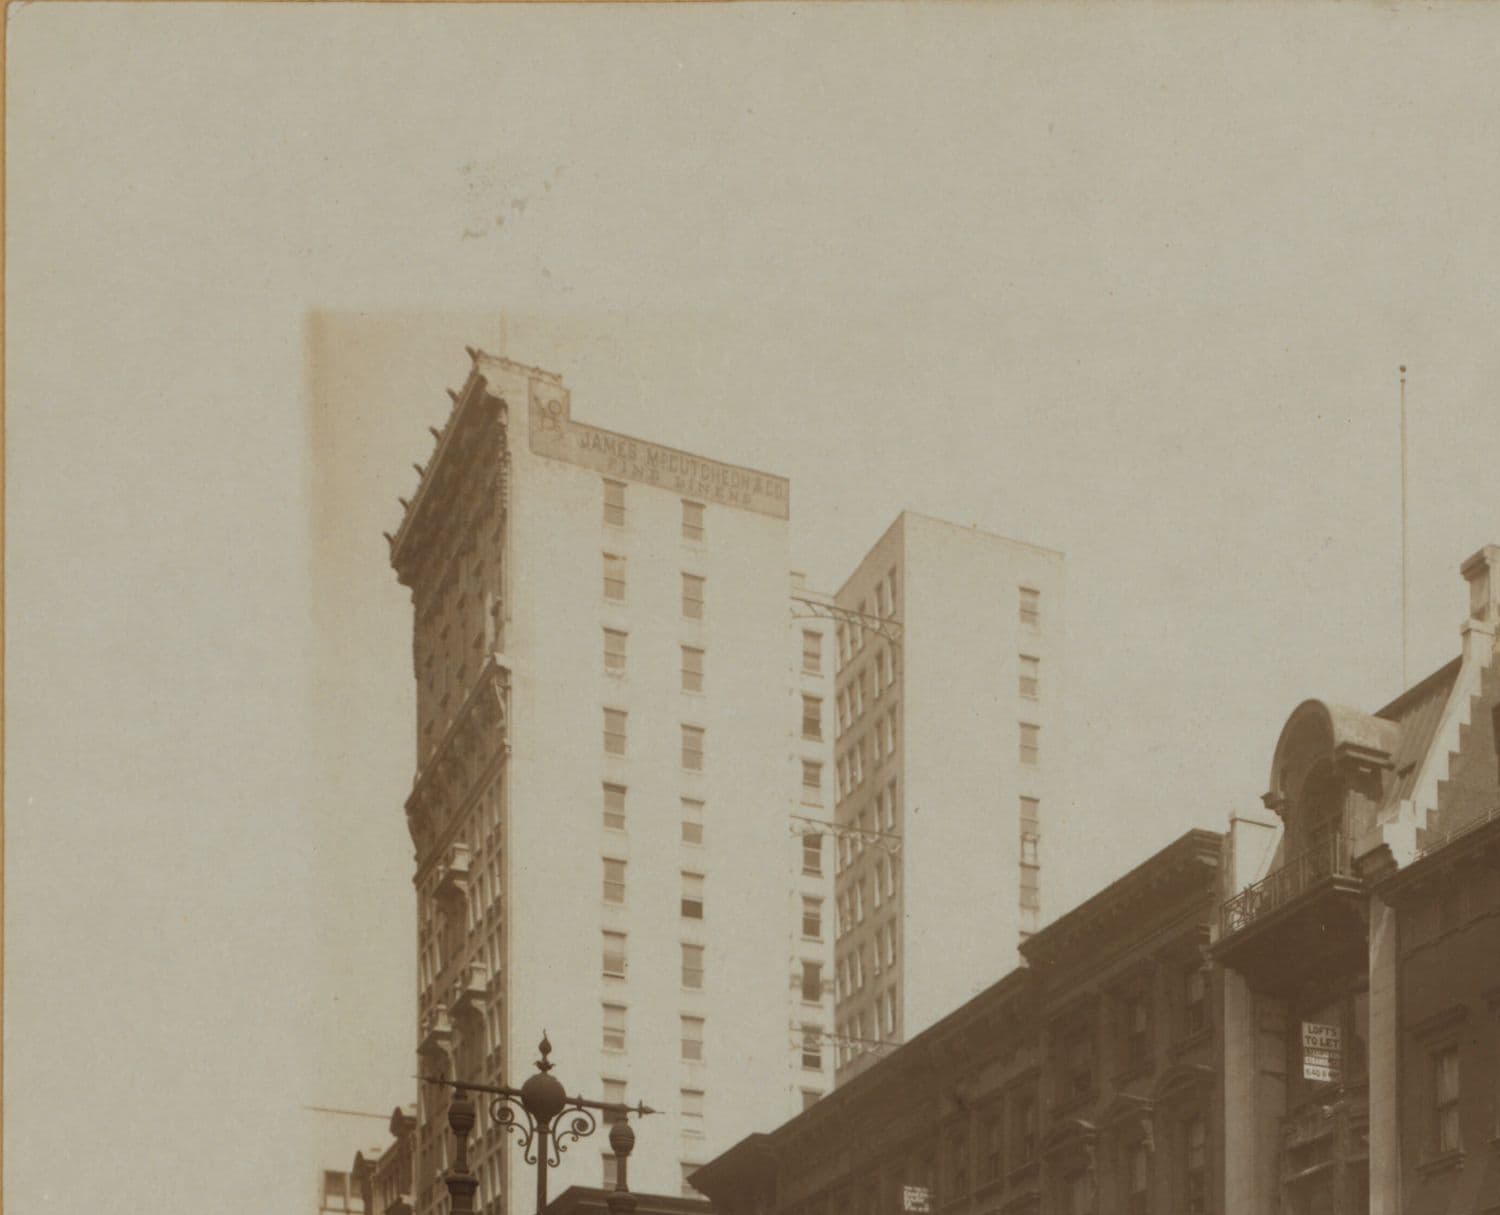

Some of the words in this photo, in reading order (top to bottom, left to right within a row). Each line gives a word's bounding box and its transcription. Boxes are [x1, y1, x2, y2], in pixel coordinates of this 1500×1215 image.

[579, 431, 637, 459] JAMES
[1308, 1025, 1337, 1036] LOFTS
[1304, 1035, 1318, 1046] TO
[1320, 1038, 1339, 1049] LET
